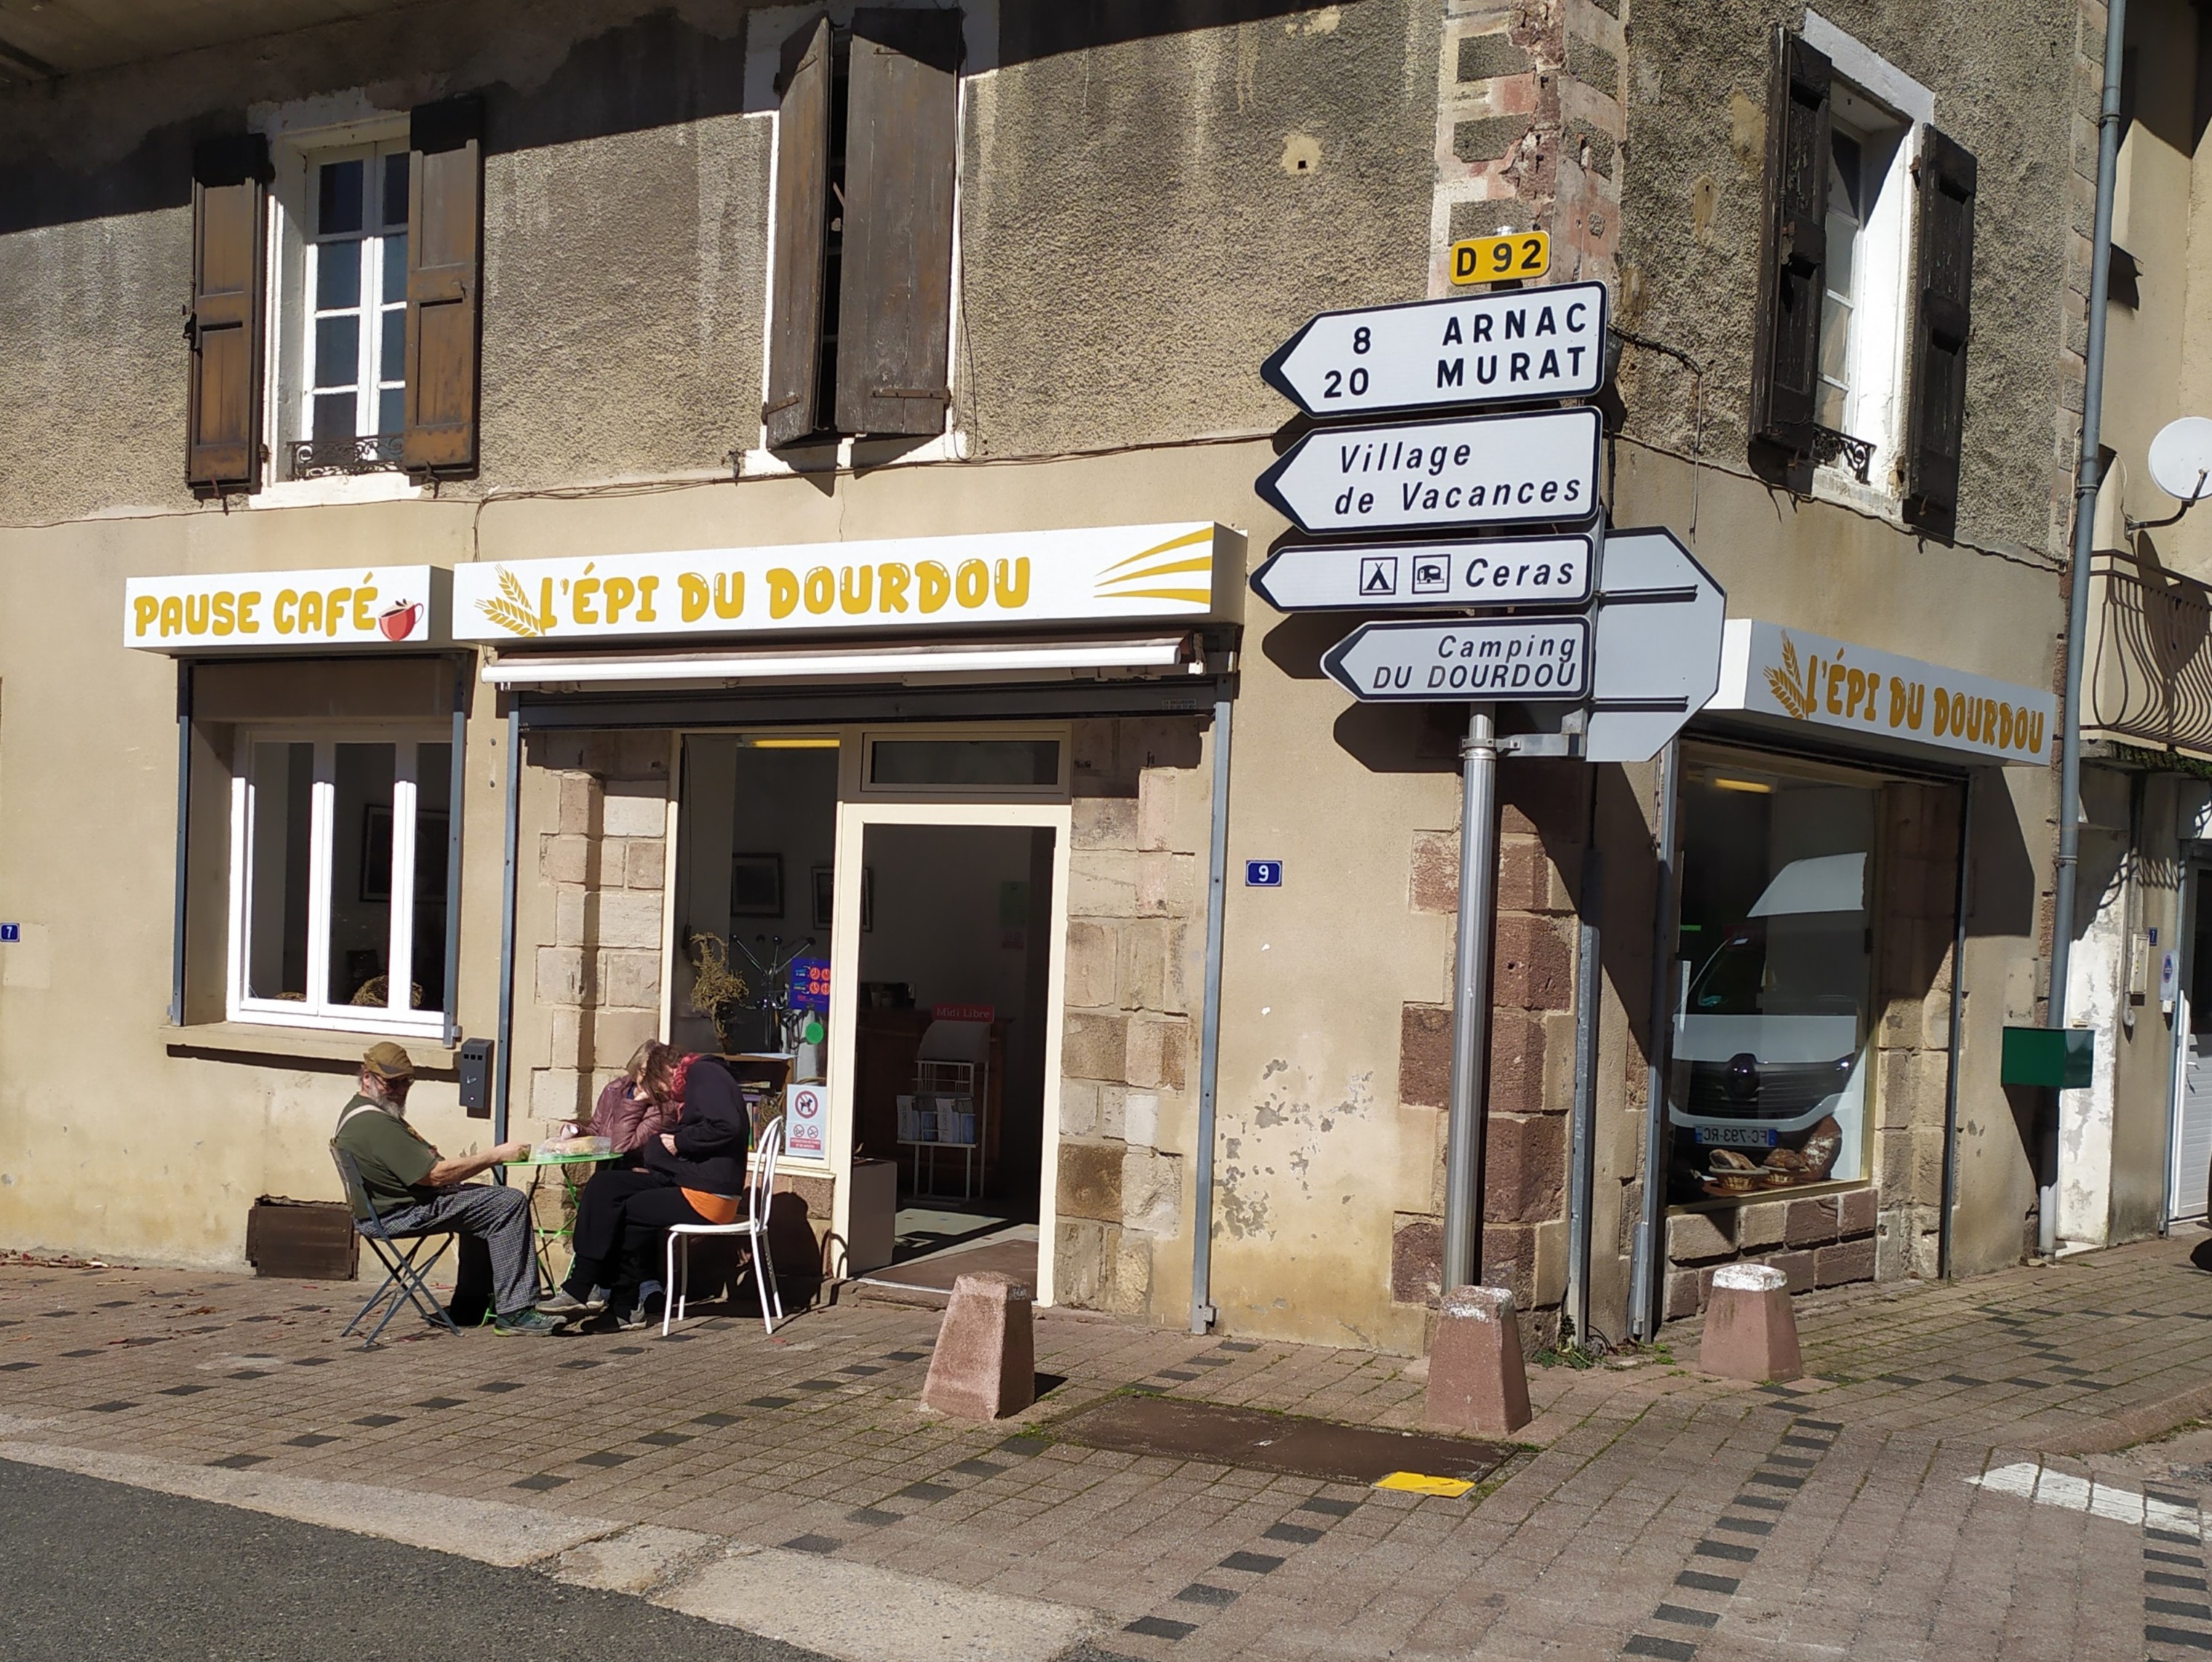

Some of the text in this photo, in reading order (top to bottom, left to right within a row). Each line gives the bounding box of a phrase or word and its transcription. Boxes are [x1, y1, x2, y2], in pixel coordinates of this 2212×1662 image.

[1456, 239, 1541, 277] D 92
[1353, 303, 1586, 355] 8 ARNAC
[1323, 345, 1586, 397] 20 MURAT
[1341, 441, 1471, 476] Village
[1335, 479, 1581, 515] de Vacances
[1466, 558, 1574, 588] Ceras
[133, 571, 379, 638] PAUSE CAFÉ
[539, 556, 1031, 630] L'ÉPI DU DOURDOU
[1438, 634, 1576, 665] Camping
[1373, 663, 1576, 689] DU DOURDOU
[1805, 647, 2045, 754] L'ÉPI DU DOURDOU
[1258, 865, 1269, 882] 9
[7, 926, 13, 938] 7
[936, 1007, 990, 1019] Midi Libre
